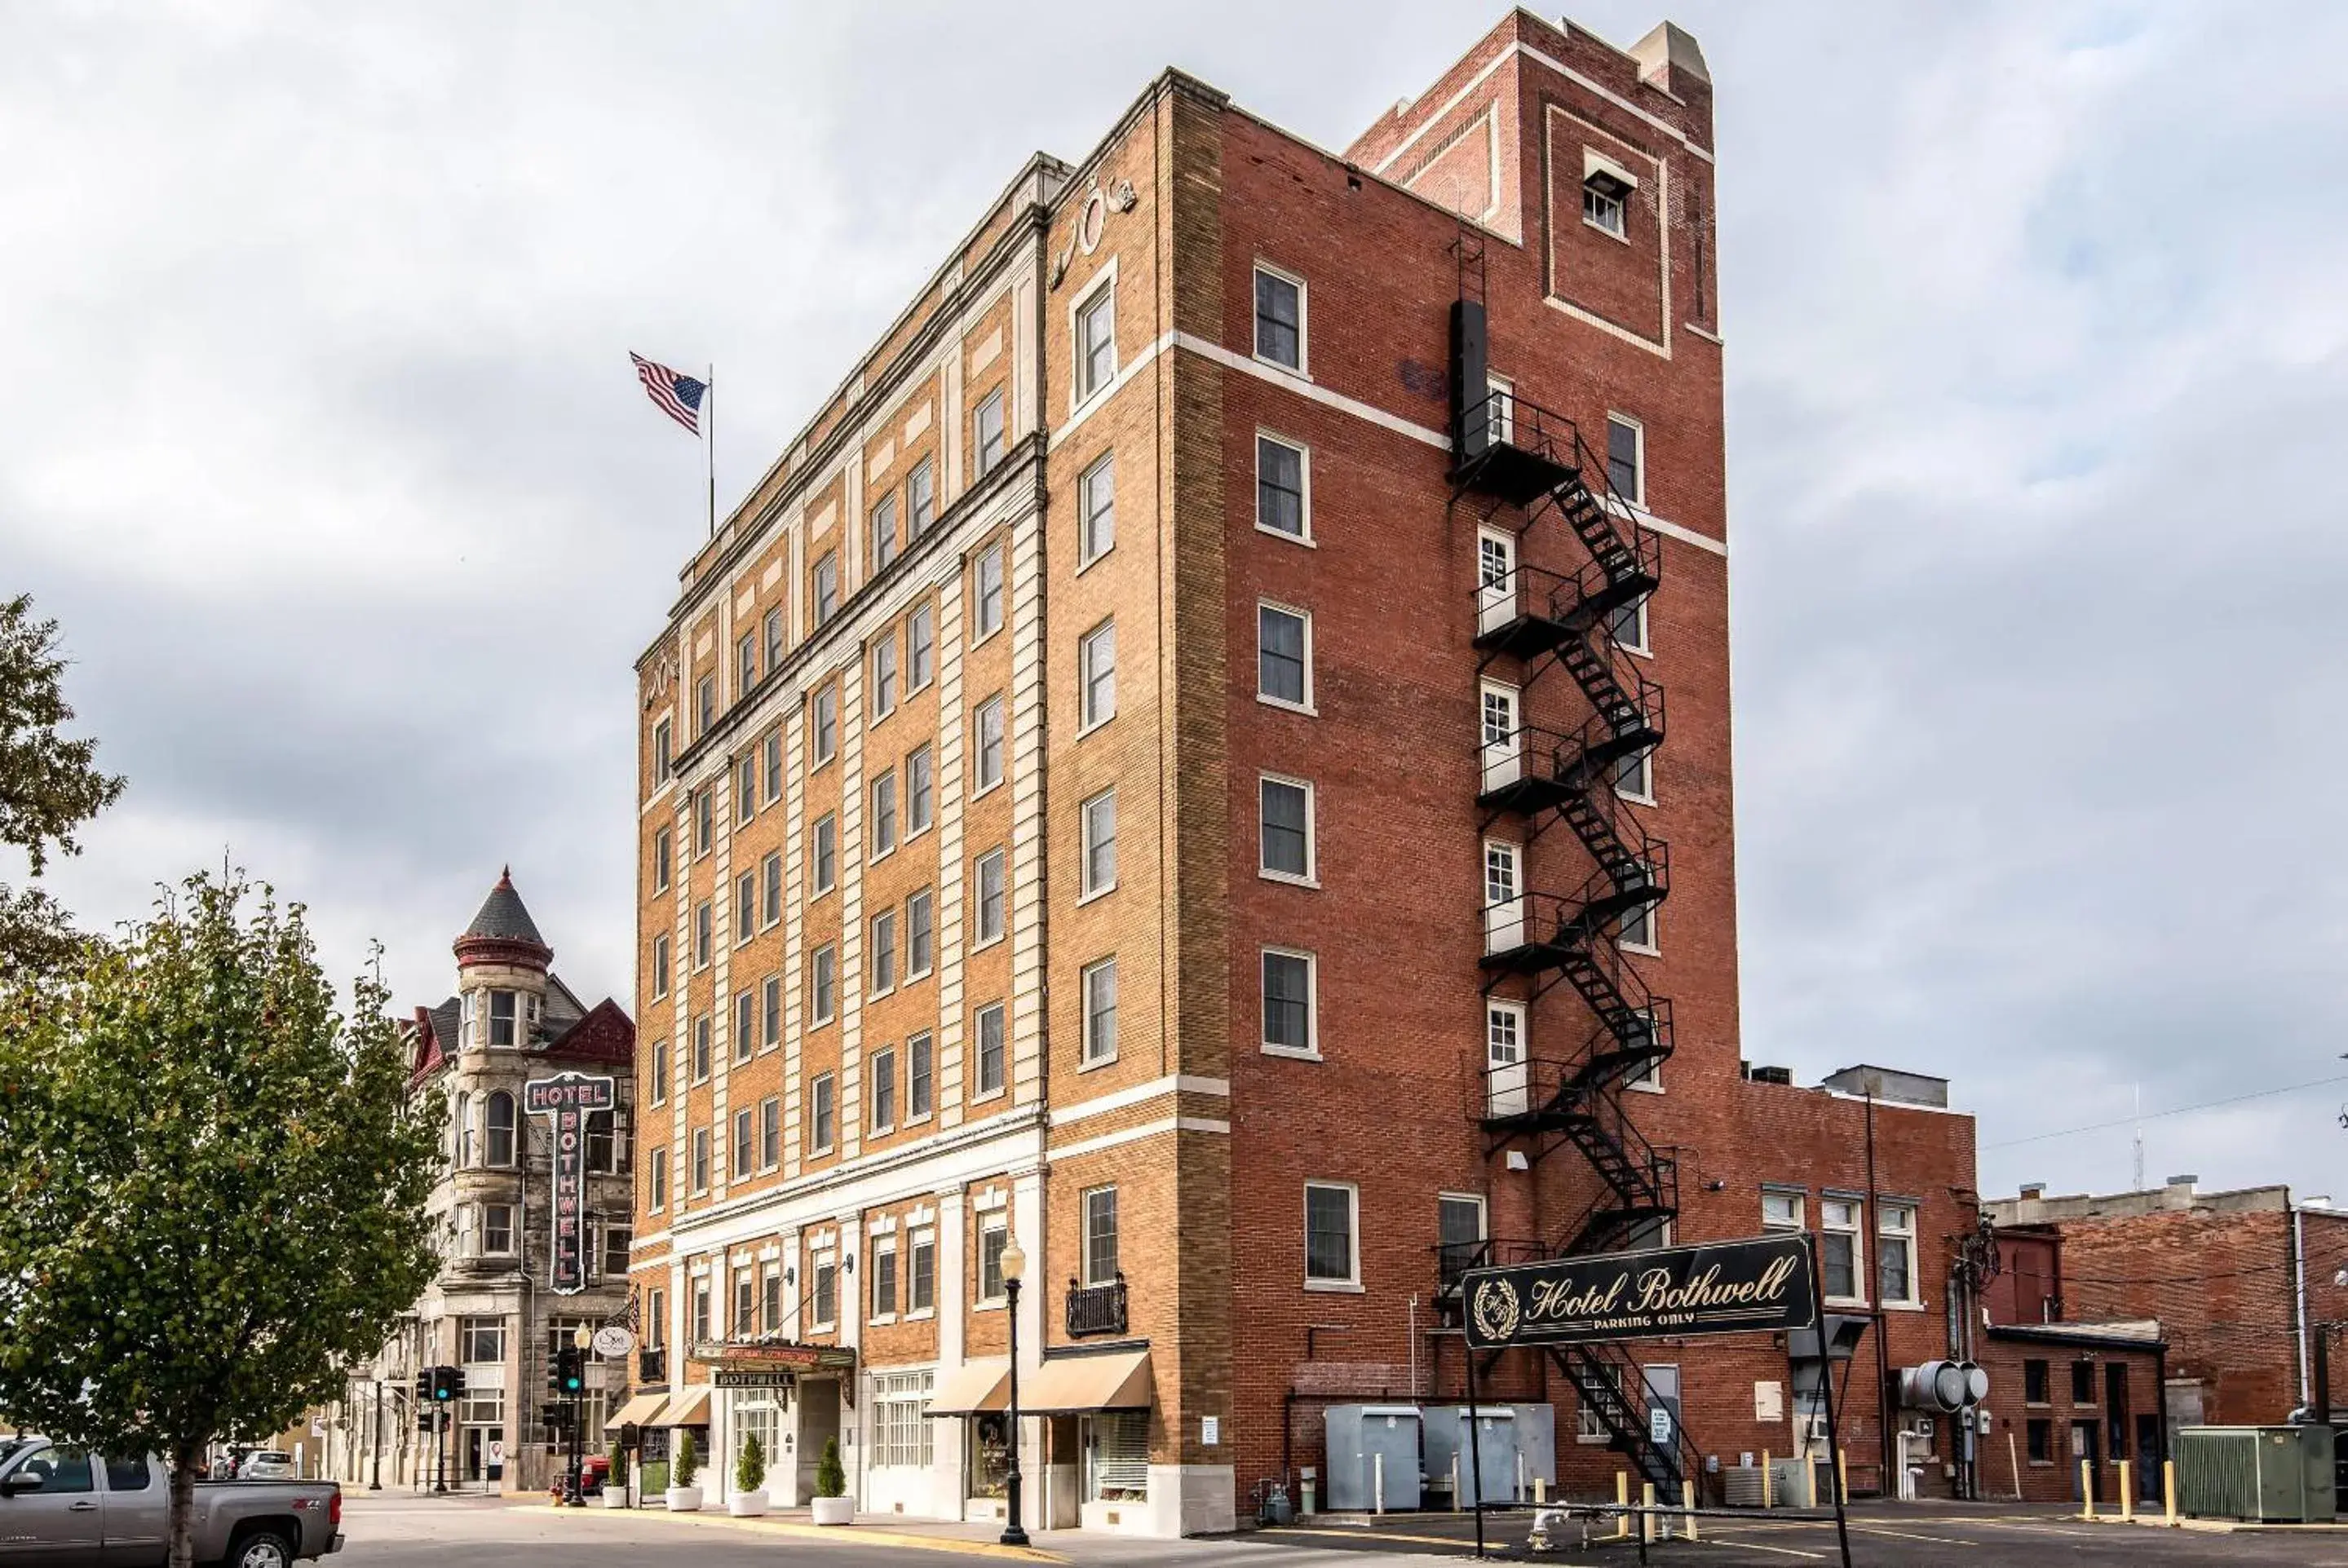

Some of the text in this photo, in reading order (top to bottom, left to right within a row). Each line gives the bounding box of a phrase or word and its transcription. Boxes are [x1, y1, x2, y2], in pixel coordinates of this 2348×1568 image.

[533, 1084, 608, 1106] HOTEL
[559, 1111, 577, 1281] BOTHWELL
[1525, 1255, 1797, 1321] Hotel Bothwell
[1594, 1312, 1695, 1330] PARKING ONLY
[719, 1373, 789, 1385] BOTHWELL
